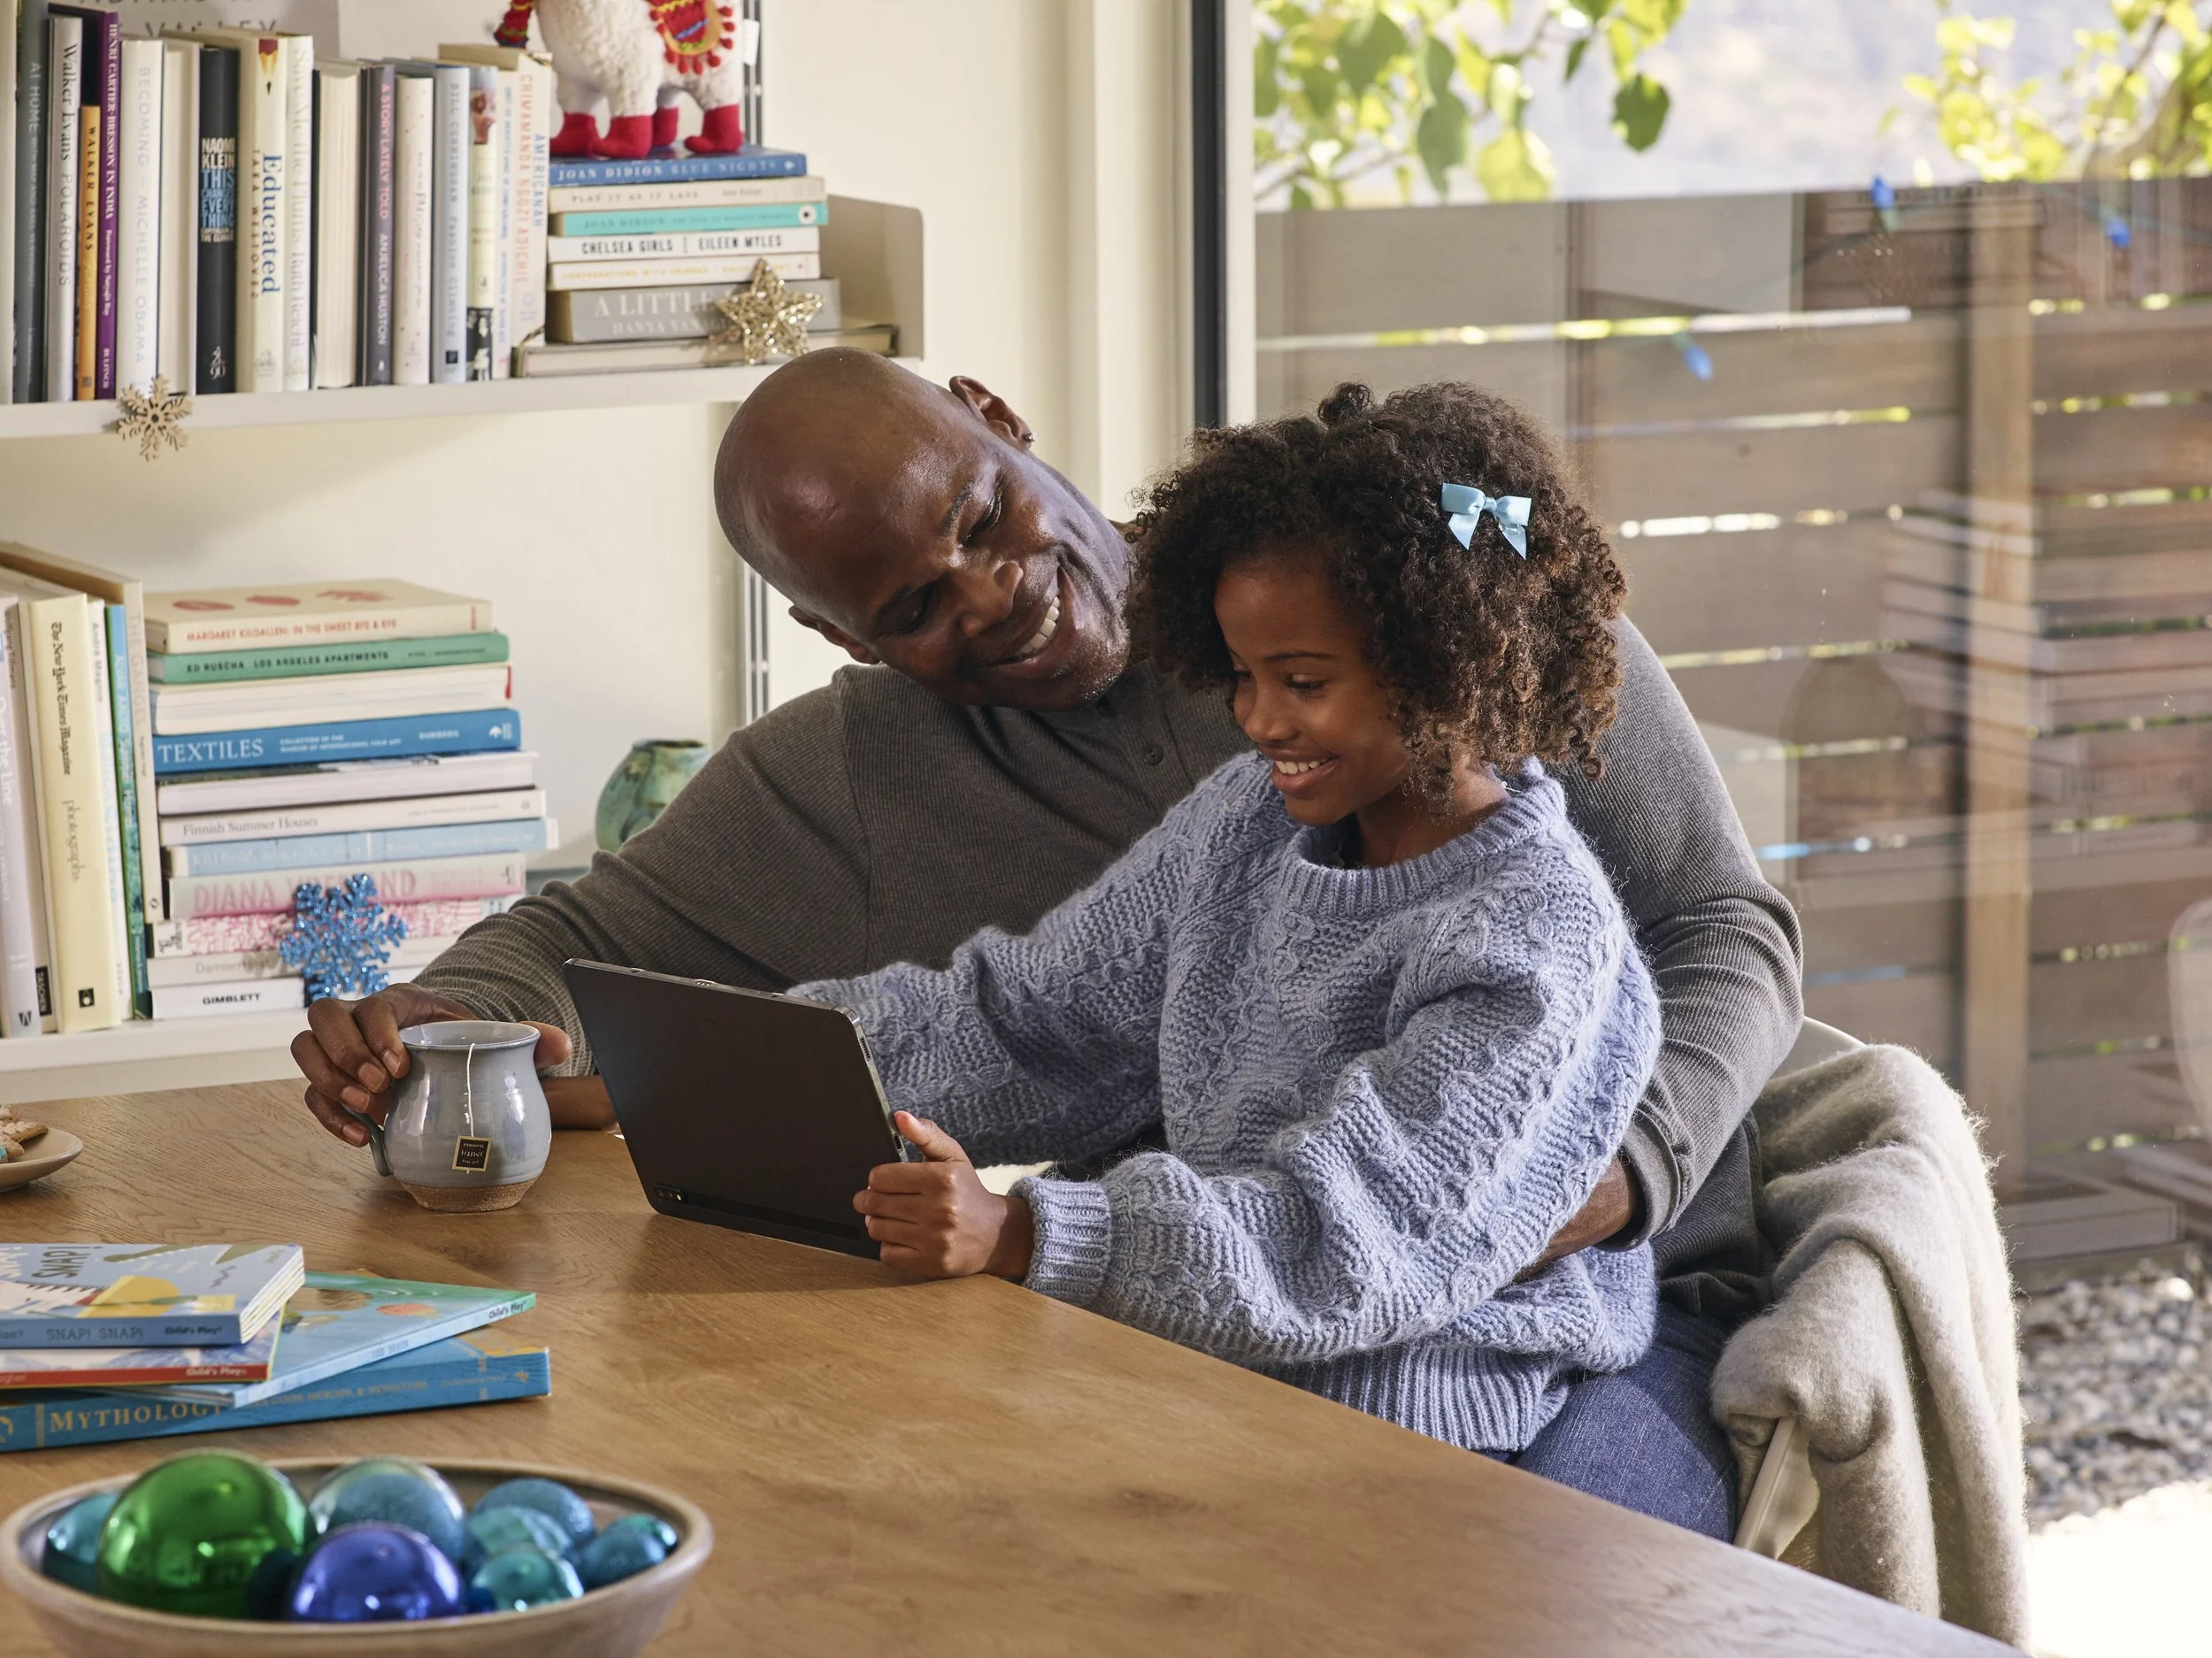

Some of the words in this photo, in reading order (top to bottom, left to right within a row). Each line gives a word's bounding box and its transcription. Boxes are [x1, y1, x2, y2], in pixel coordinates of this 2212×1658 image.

[62, 42, 78, 105] Walker
[381, 83, 391, 93] A
[28, 86, 42, 133] HOME
[137, 67, 151, 168] BECOMING
[380, 95, 391, 136] STORY
[519, 74, 534, 172] CHIMAMANDA
[60, 111, 75, 161] Evans
[87, 127, 96, 189] WALKER
[202, 152, 235, 169] KLEIN
[250, 149, 260, 194] TARA
[380, 138, 390, 183] LATELY
[557, 169, 598, 181] JOAN
[604, 165, 664, 179] DIDION
[105, 170, 115, 183] IN
[203, 169, 234, 189] THIS
[533, 134, 546, 227] AMERICANAH
[104, 187, 115, 219] INDIA
[379, 187, 390, 220] TOLD
[517, 178, 532, 222] NGOZI
[58, 173, 73, 287] POLAROIDS
[85, 201, 95, 250] EVANS
[135, 194, 150, 286] MICHELLE
[261, 152, 284, 295] Educated
[581, 241, 634, 255] CHELSEA
[639, 239, 673, 252] GIRLS
[698, 236, 740, 251] EILEEN
[744, 234, 783, 248] MYLES
[594, 295, 611, 317] A
[620, 289, 715, 316] LITTLE
[134, 296, 148, 365] OBAMA
[612, 320, 665, 334] HANYA
[128, 611, 142, 649] THE
[186, 629, 236, 642] MARGARET
[306, 623, 320, 634] THE
[324, 620, 352, 633] SWEET
[53, 643, 65, 666] New
[186, 663, 201, 674] ED
[203, 660, 245, 672] RUSCHA
[253, 658, 273, 669] LOS
[275, 656, 321, 667] ANGELES
[323, 650, 389, 664] APARTMENTS
[52, 667, 67, 694] York
[131, 654, 147, 726] GANGES
[57, 694, 69, 725] Times
[0, 741, 12, 769] the
[58, 725, 73, 776] Magazine
[157, 738, 264, 764] TEXTILES
[1, 771, 15, 807] Line
[62, 800, 85, 882] photographs
[182, 822, 225, 836] Finnish
[227, 819, 275, 833] Summer
[278, 816, 319, 829] Houses
[195, 879, 277, 911] DIANA
[202, 991, 261, 1005] GIMBLETT
[31, 1245, 104, 1278] SNAP!
[488, 1307, 510, 1321] Child's
[510, 1301, 526, 1315] Play
[45, 1326, 91, 1342] SNAP!
[97, 1325, 143, 1340] SNAP!
[164, 1326, 196, 1336] Child's
[185, 1366, 219, 1377] Child's
